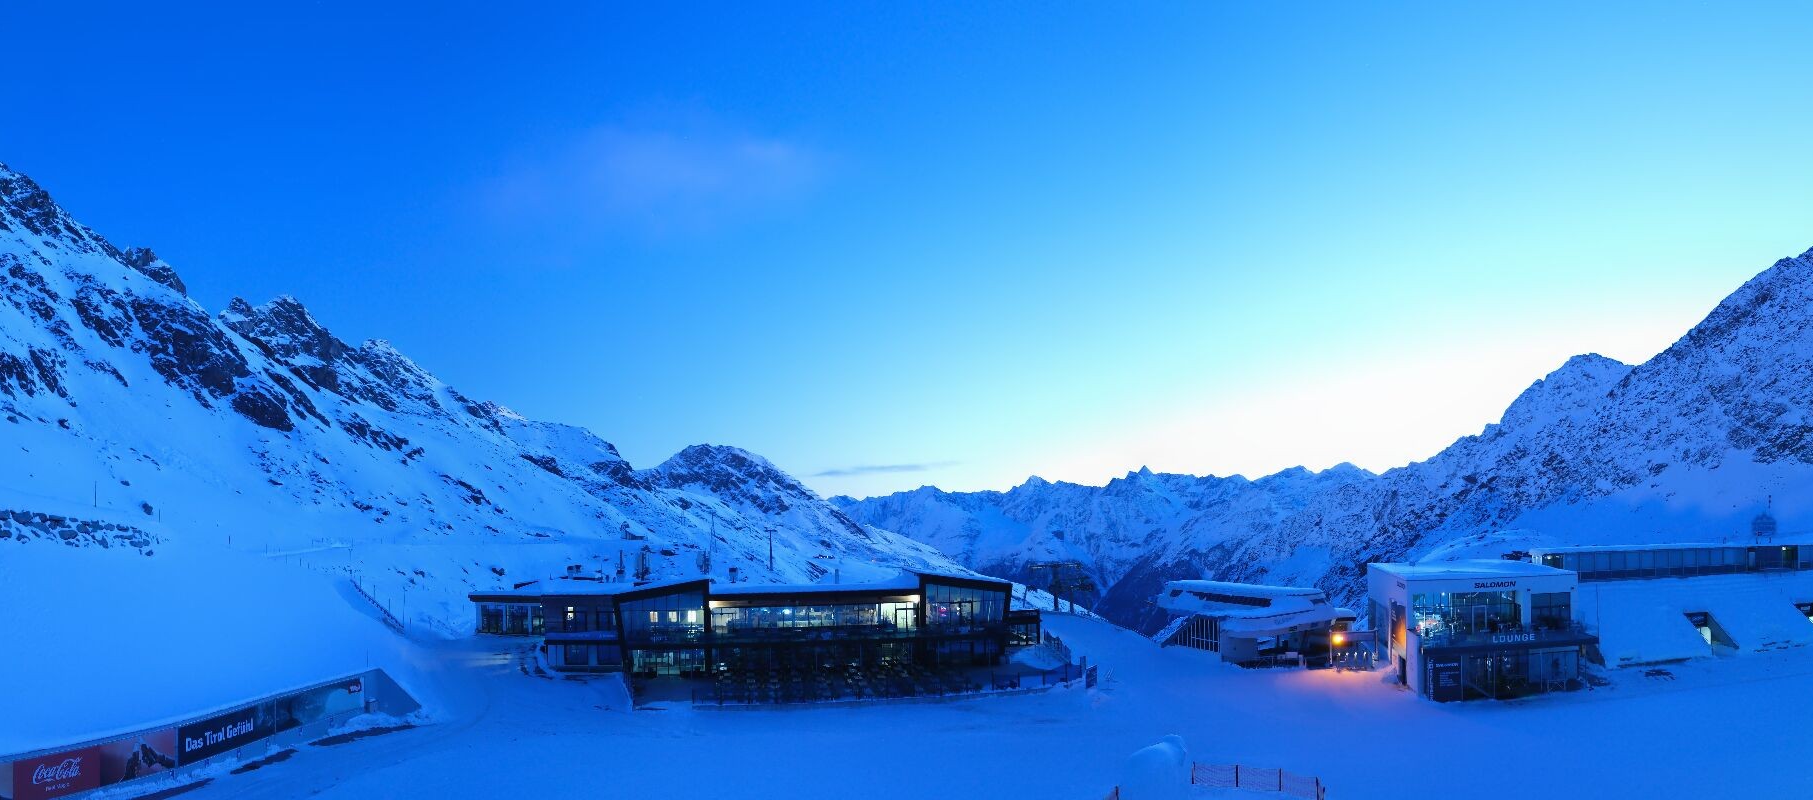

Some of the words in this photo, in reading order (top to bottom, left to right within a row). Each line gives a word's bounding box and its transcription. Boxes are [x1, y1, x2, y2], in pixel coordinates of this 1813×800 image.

[1474, 581, 1516, 589] SALOMON
[1492, 633, 1536, 643] LOUNGE
[185, 737, 203, 752] Das
[204, 727, 226, 746] Tirol
[226, 718, 254, 739] Gefühl
